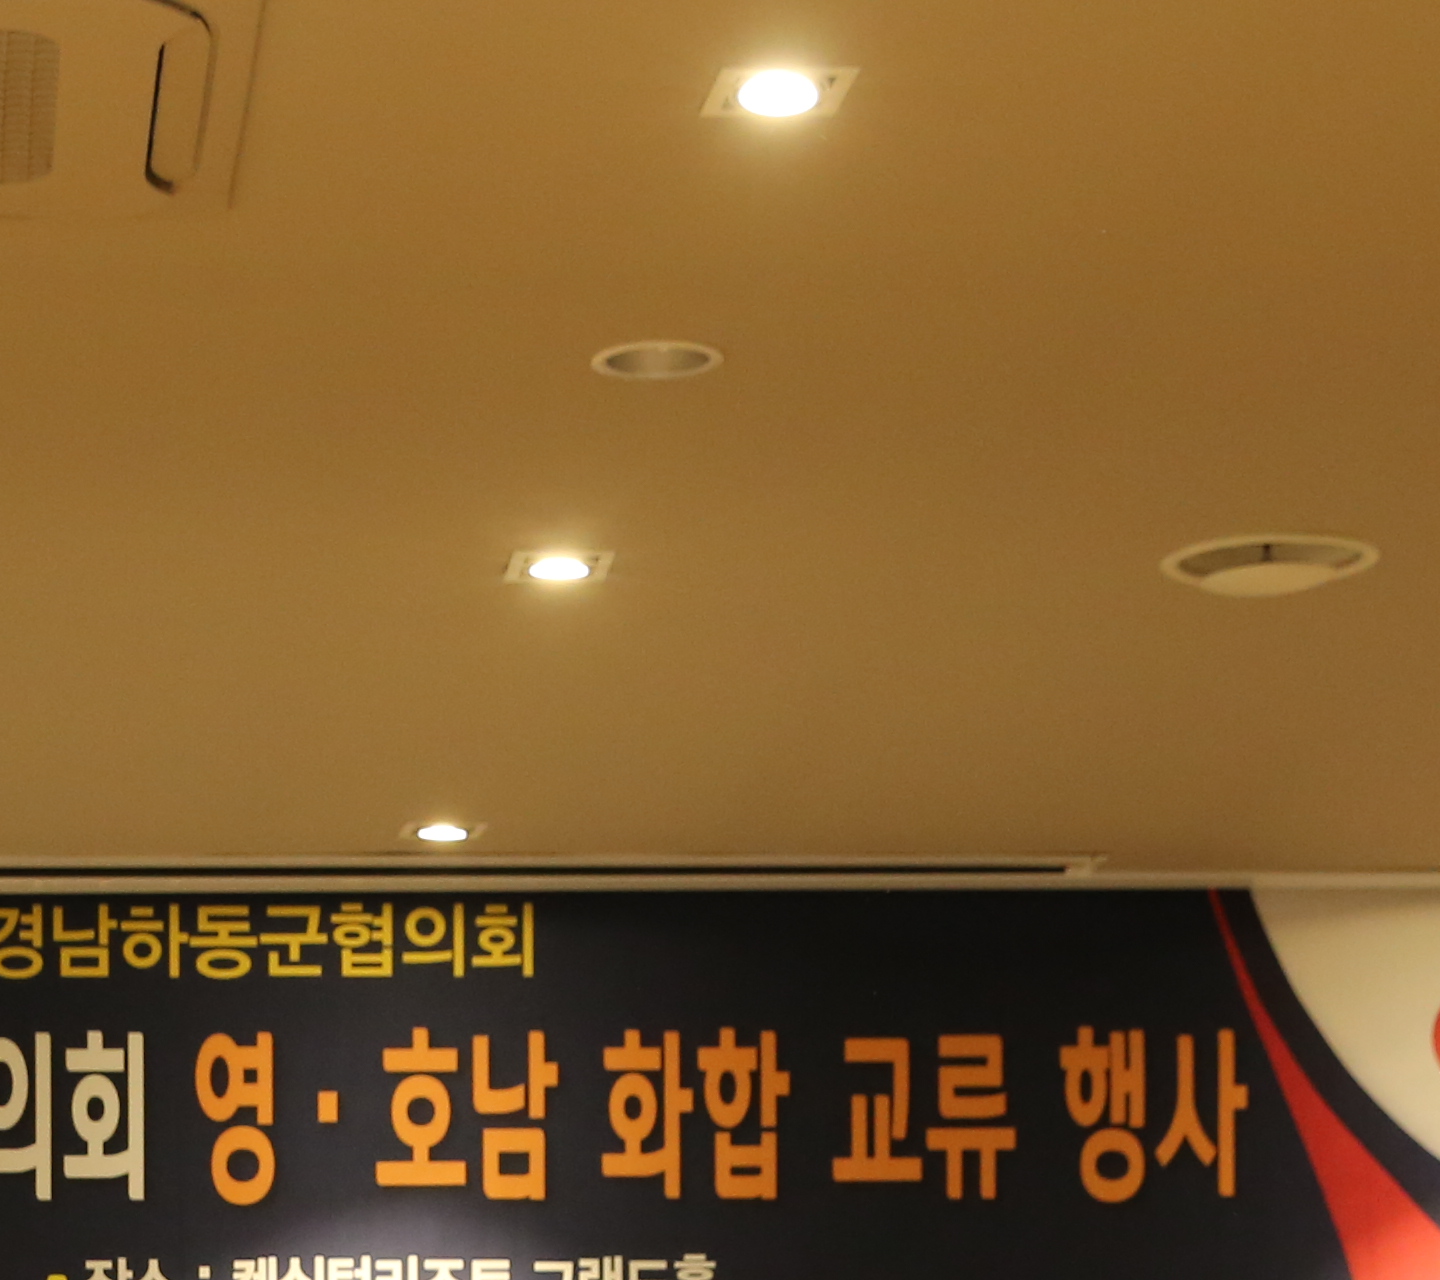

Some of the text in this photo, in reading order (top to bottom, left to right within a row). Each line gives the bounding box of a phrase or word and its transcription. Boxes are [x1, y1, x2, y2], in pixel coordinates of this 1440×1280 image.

[600, 1026, 792, 1201] 화합
[831, 1034, 1018, 1201] 교류
[1059, 1026, 1250, 1204] 행사
